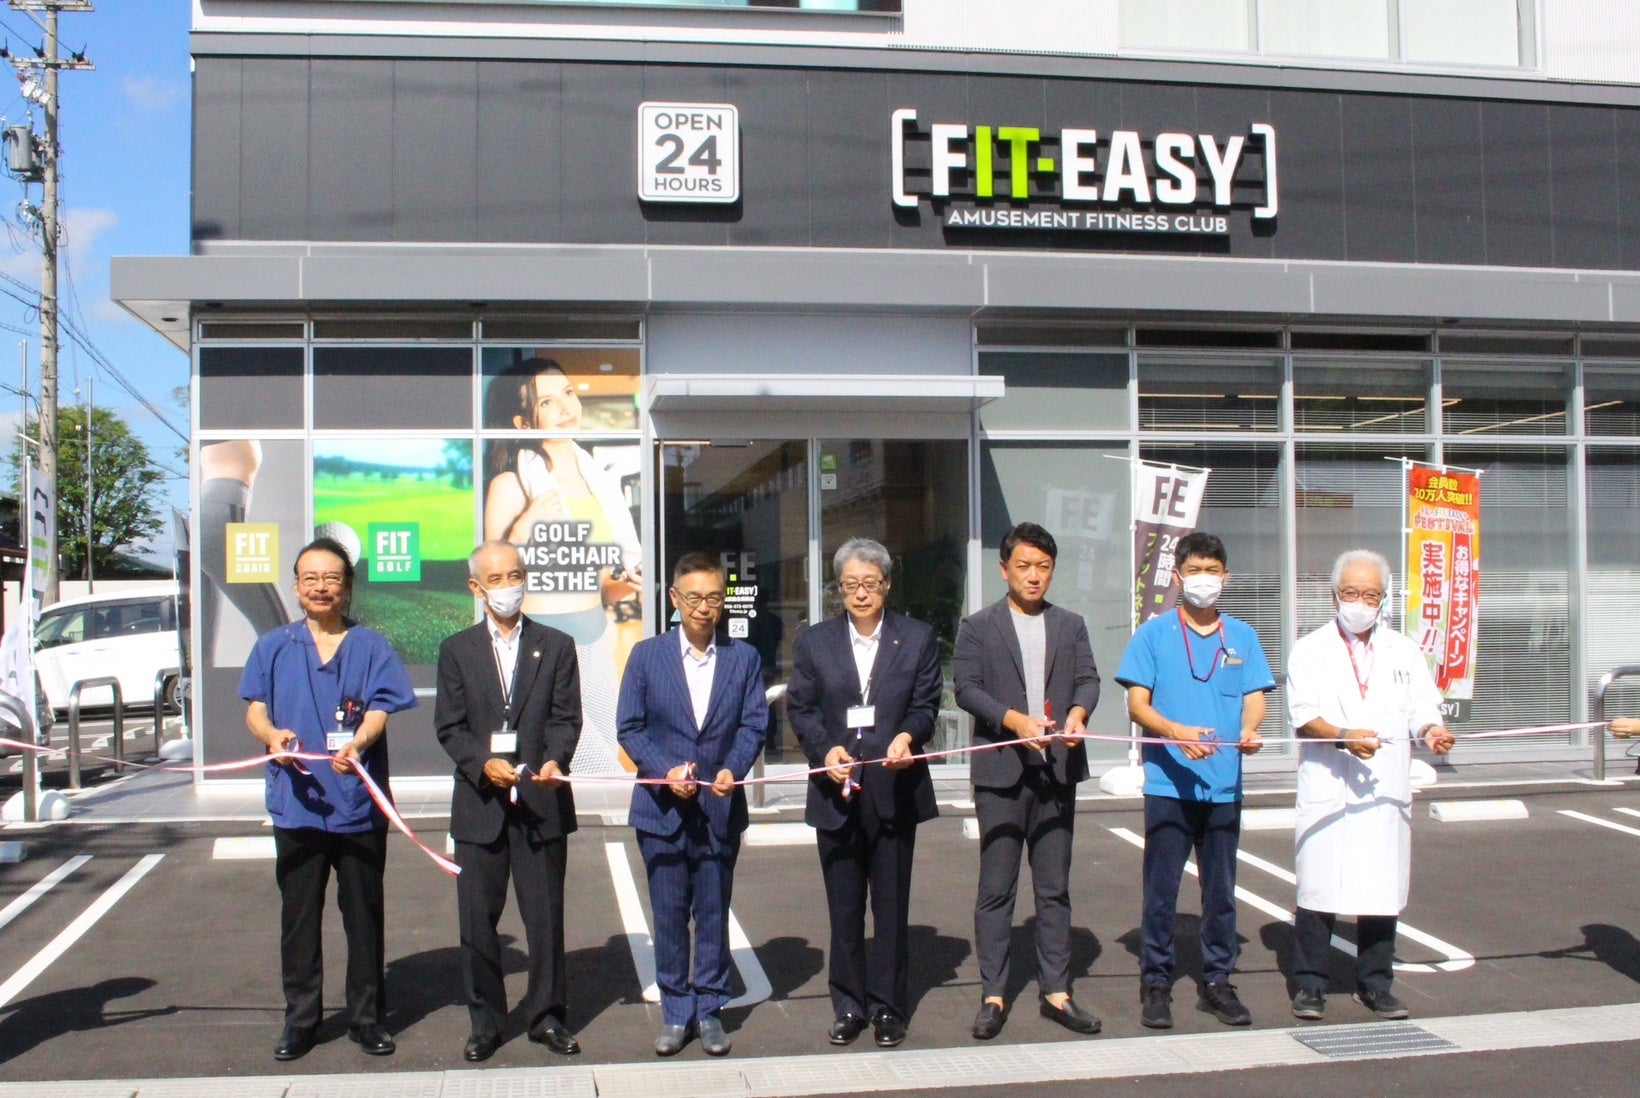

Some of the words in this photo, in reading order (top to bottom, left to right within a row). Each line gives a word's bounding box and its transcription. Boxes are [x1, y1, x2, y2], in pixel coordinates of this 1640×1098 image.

[654, 112, 722, 130] OPEN
[654, 133, 722, 175] 24
[654, 177, 722, 191] HOURS
[947, 209, 1081, 229] AMUSEMENT
[1085, 212, 1169, 231] FITNESS
[1174, 214, 1228, 233] CLUB
[235, 532, 271, 556] FIT
[376, 531, 412, 554] FIT
[534, 523, 591, 542] GOLF
[517, 545, 621, 566] MS-CHAIR
[527, 566, 598, 591] ESTHÉ
[1448, 544, 1470, 668] お得なキャンペーン
